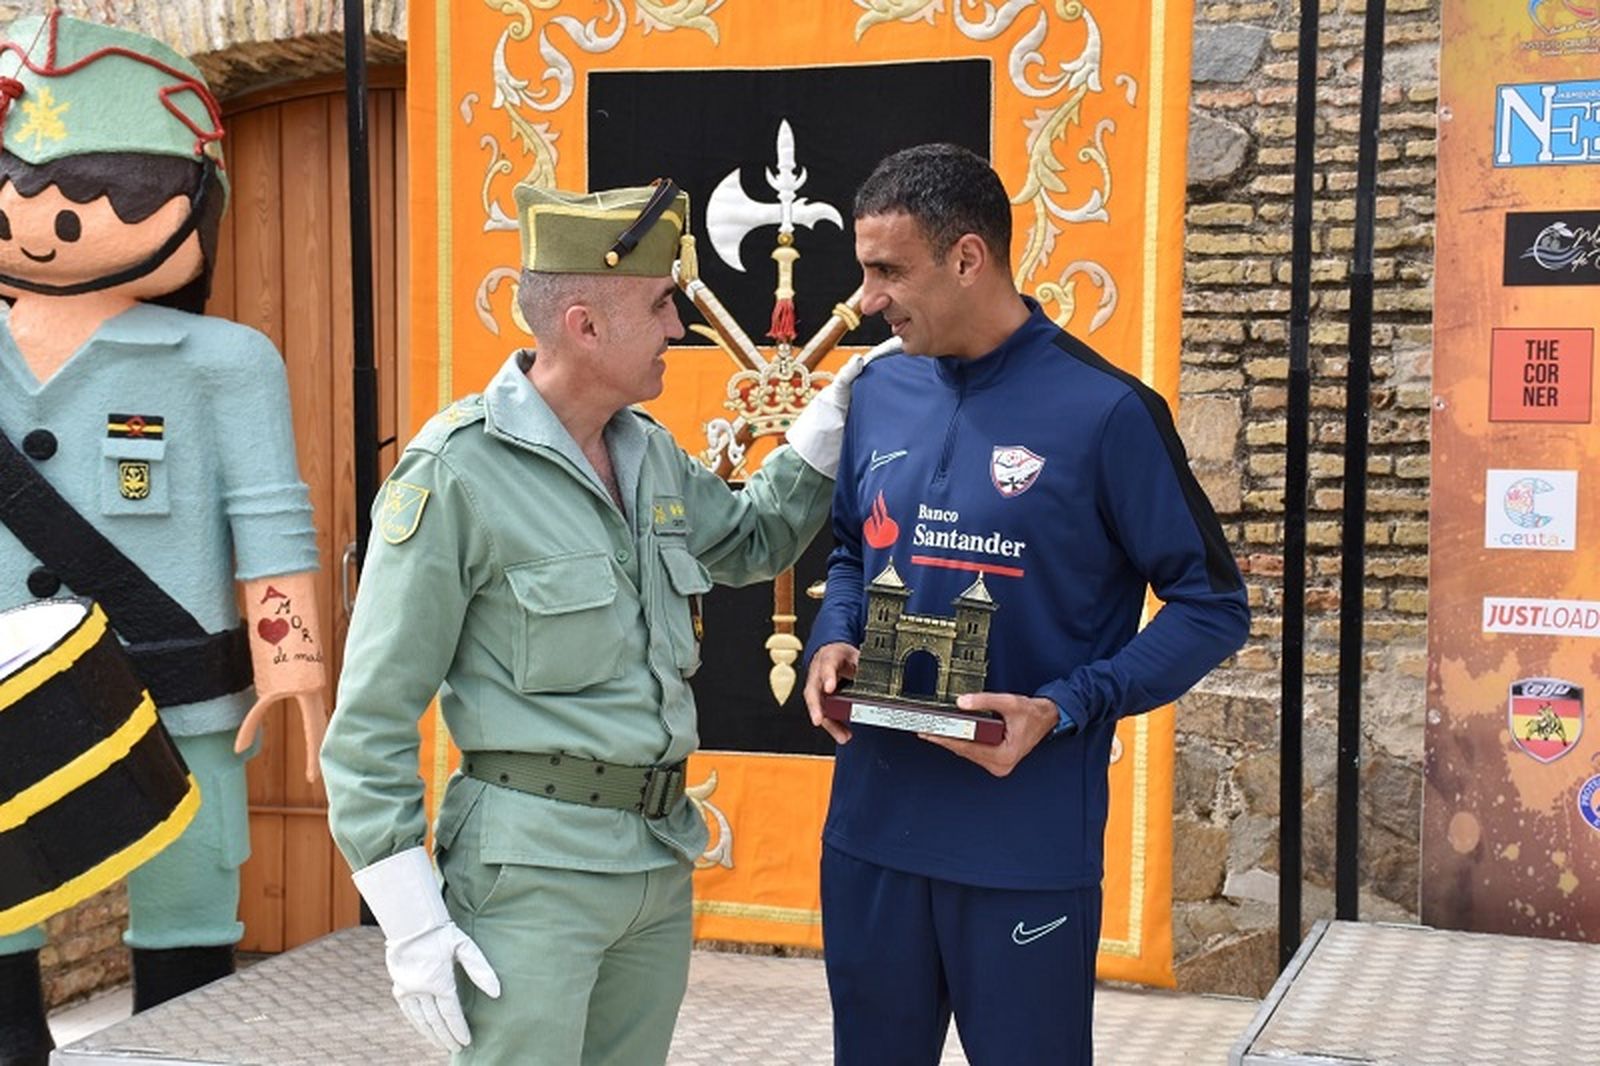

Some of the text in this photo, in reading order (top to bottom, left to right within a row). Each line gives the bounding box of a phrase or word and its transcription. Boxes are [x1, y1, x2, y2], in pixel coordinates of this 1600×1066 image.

[1497, 86, 1600, 163] NE
[1525, 339, 1559, 361] THE
[1523, 363, 1559, 384] COR
[1523, 386, 1558, 407] NER
[918, 504, 959, 523] Banco
[913, 523, 1026, 558] Santander
[1499, 531, 1560, 546] ceuta
